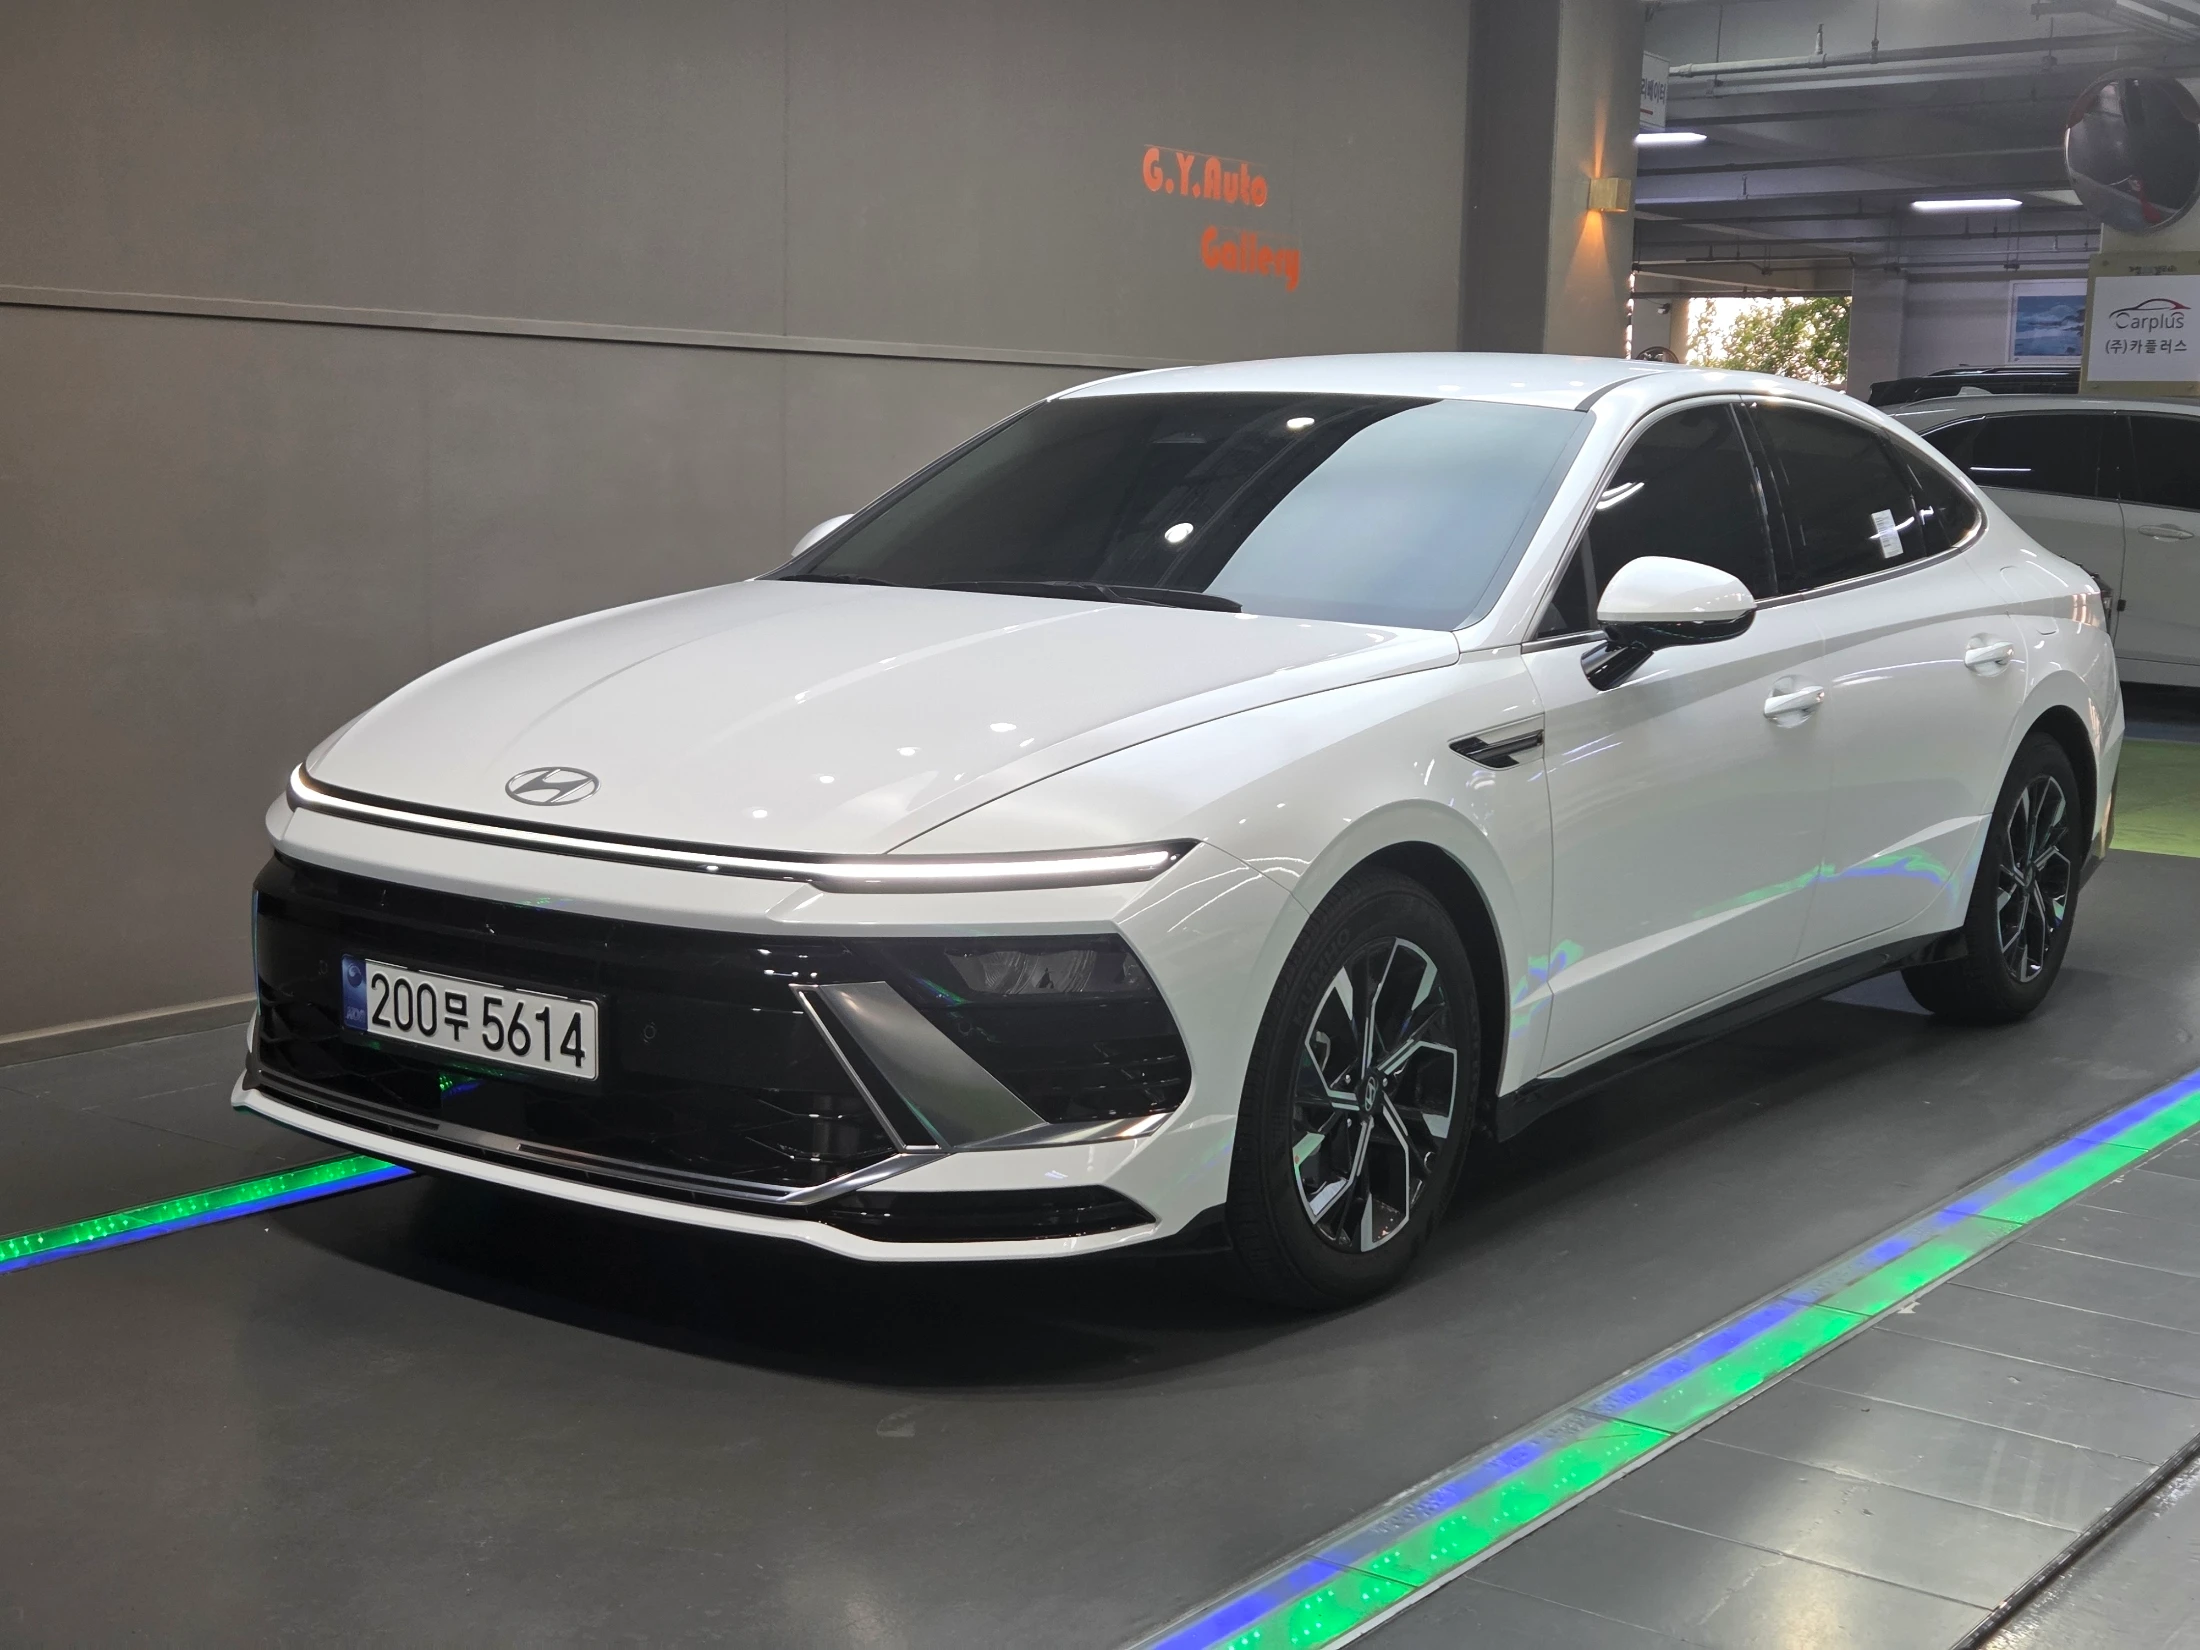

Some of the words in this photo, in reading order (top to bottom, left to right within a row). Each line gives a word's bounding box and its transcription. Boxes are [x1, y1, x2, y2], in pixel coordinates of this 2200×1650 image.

[1143, 147, 1267, 207] G.Y.Auto
[1201, 225, 1300, 292] Gallery
[2105, 339, 2187, 354] (주)카플러스
[2115, 311, 2185, 333] Carplus
[1292, 927, 1351, 1025] KUMHO
